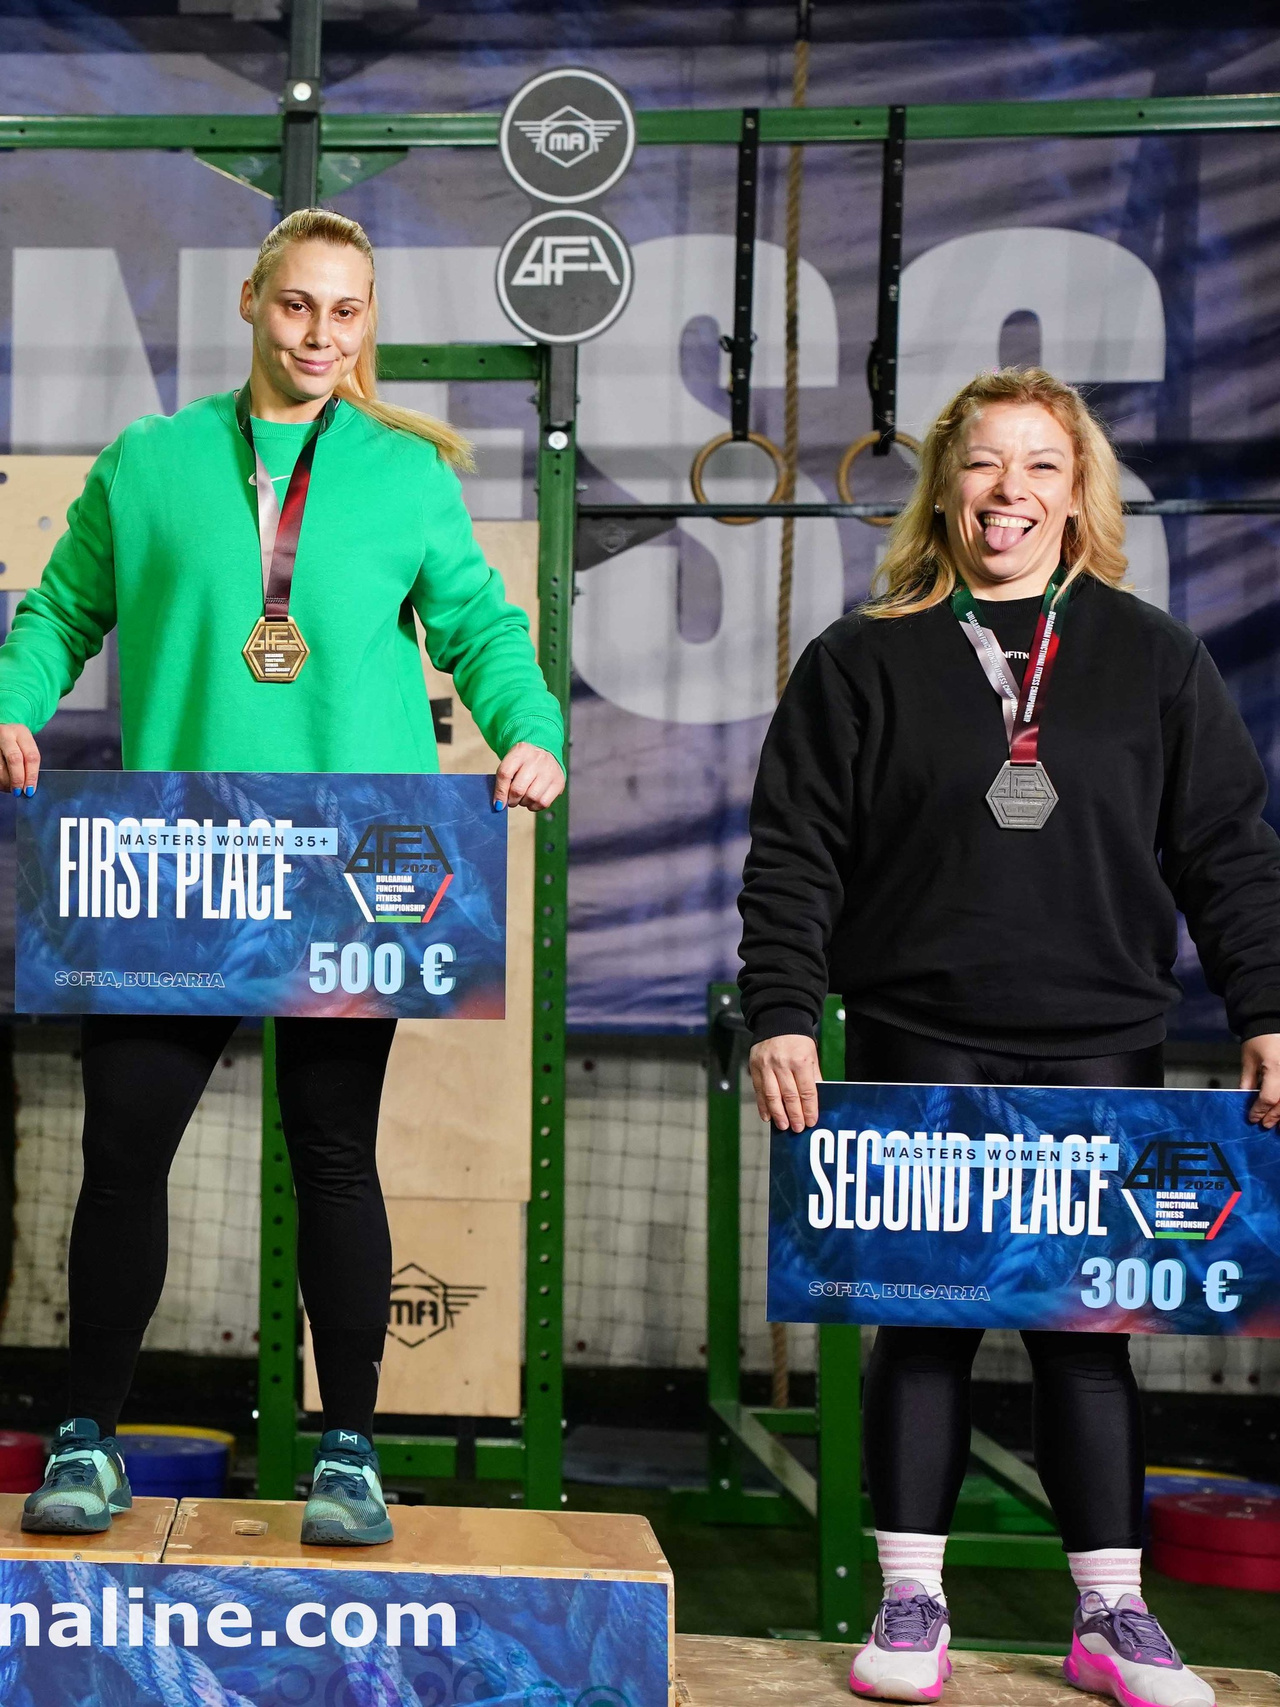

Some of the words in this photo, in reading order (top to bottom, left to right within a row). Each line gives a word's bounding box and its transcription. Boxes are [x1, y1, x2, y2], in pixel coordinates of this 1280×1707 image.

[119, 834, 208, 847] MASTERS
[217, 834, 285, 848] WOMEN
[294, 835, 329, 848] 35+
[58, 817, 164, 920] FIRST
[176, 818, 292, 921] PLACE
[400, 863, 438, 874] 2026
[375, 875, 413, 883] BULGARIAN
[375, 885, 415, 893] FUNCTIONAL
[375, 894, 402, 902] FITNESS
[375, 904, 425, 912] CHAMPIONSHIP
[308, 942, 408, 996] 500
[419, 942, 457, 996] €
[54, 970, 123, 990] SOFIA,
[124, 972, 225, 989] BULGARIA
[882, 1146, 977, 1161] MASTERS
[987, 1148, 1061, 1162] WOMEN
[1071, 1150, 1109, 1163] 35+
[808, 1128, 971, 1232] SECOND
[981, 1134, 1109, 1237] PLACE
[1183, 1181, 1225, 1190] 2026
[1156, 1191, 1196, 1200] BULGARIAN
[1156, 1201, 1199, 1210] FUNCTIONAL
[1155, 1210, 1184, 1219] FITNESS
[1155, 1220, 1210, 1229] CHAMPIONSHIP
[1081, 1256, 1187, 1311] 300
[1202, 1260, 1243, 1313] €
[808, 1281, 881, 1300] SOFIA,
[881, 1283, 991, 1302] BULGARIA
